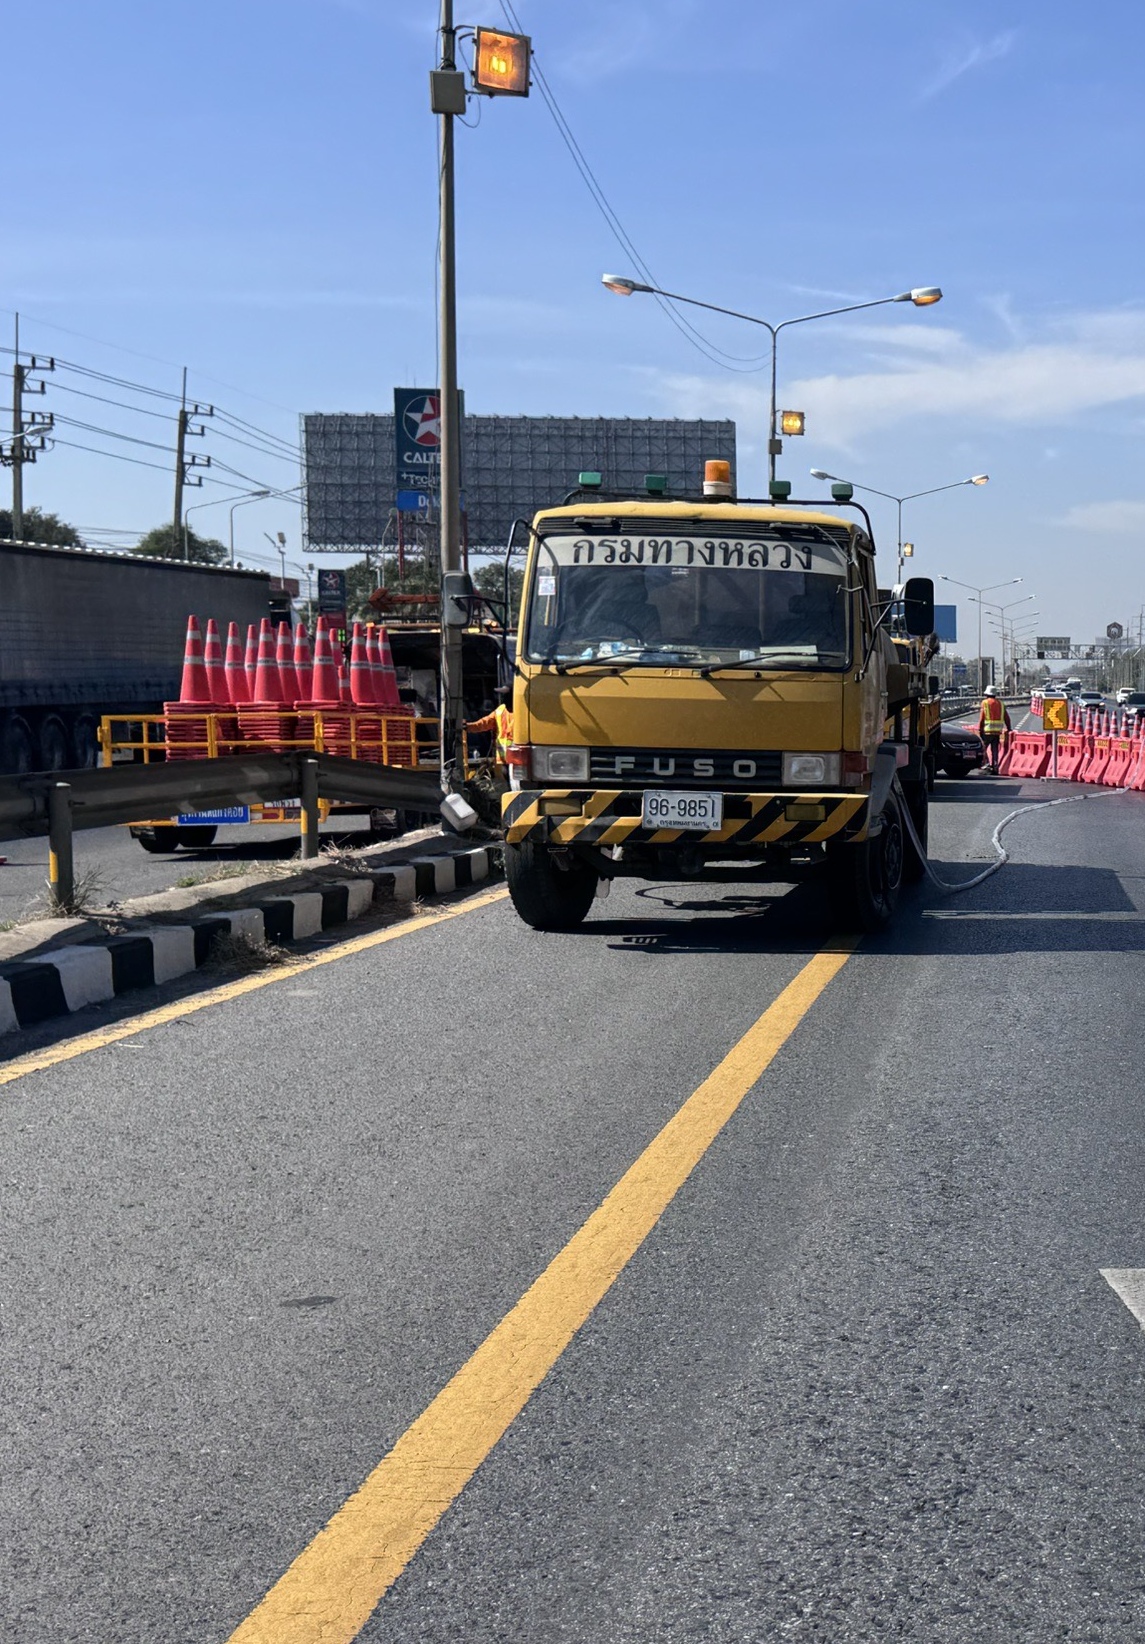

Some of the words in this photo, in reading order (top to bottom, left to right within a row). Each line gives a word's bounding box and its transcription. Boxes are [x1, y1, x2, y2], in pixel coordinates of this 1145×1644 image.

[403, 451, 442, 464] CALTE
[572, 538, 813, 570] กรมทางหลวง
[614, 756, 757, 778] FUSO
[648, 798, 716, 818] 96-9851
